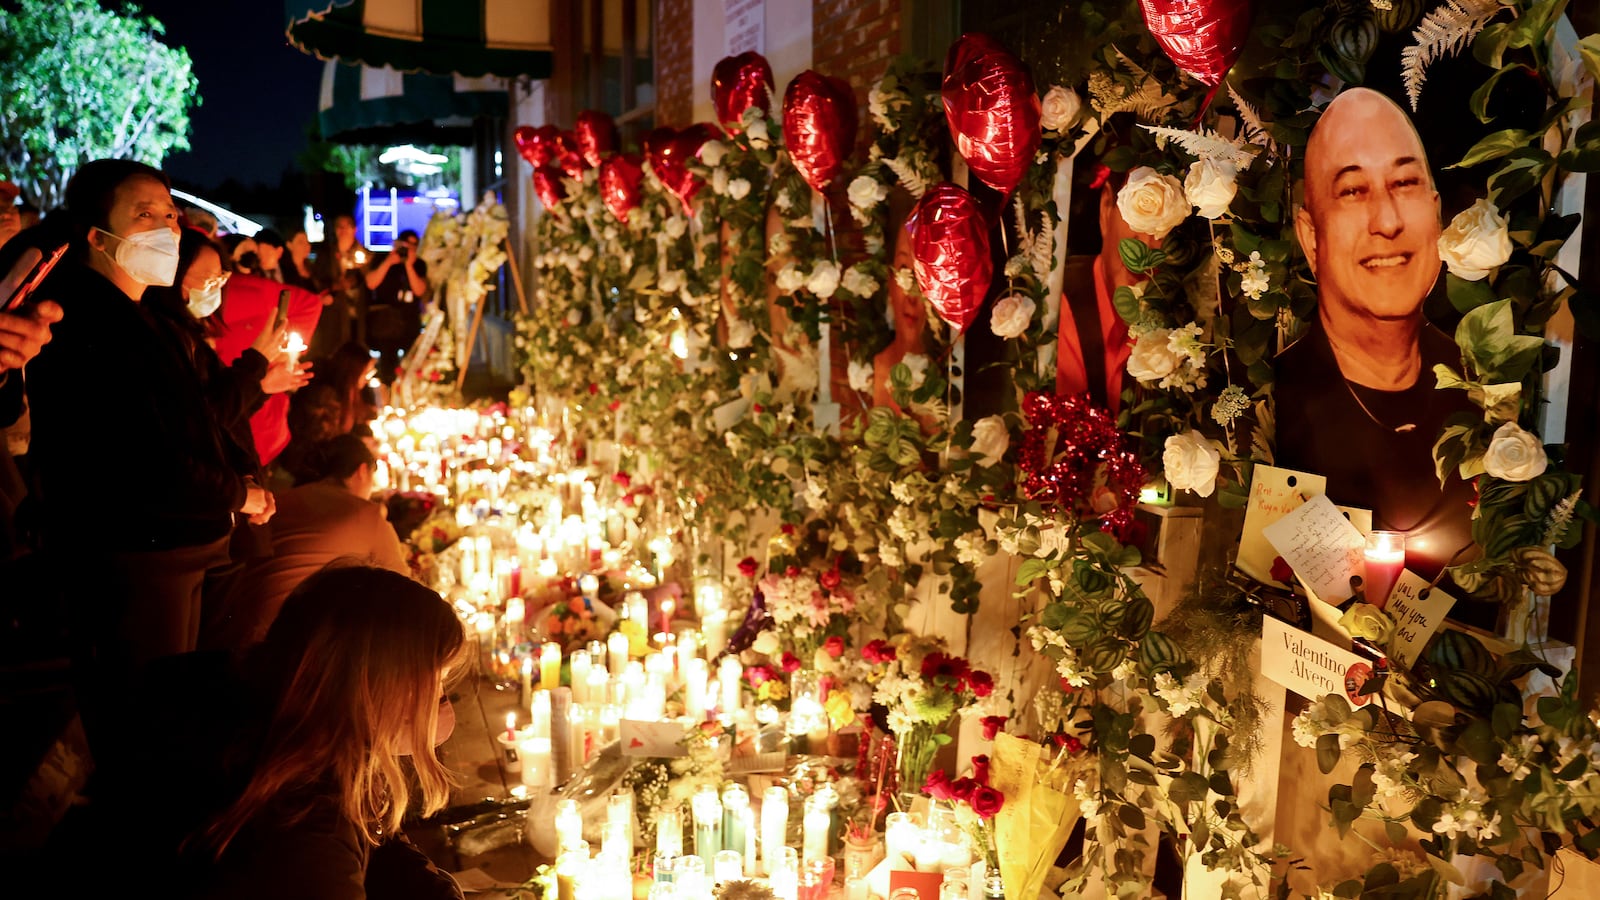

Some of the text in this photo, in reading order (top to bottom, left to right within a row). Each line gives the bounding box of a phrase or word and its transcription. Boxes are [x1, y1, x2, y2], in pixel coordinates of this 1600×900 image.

[1392, 599, 1427, 628] May you
[1283, 632, 1346, 676] Valentino
[1290, 658, 1334, 692] Alvero
